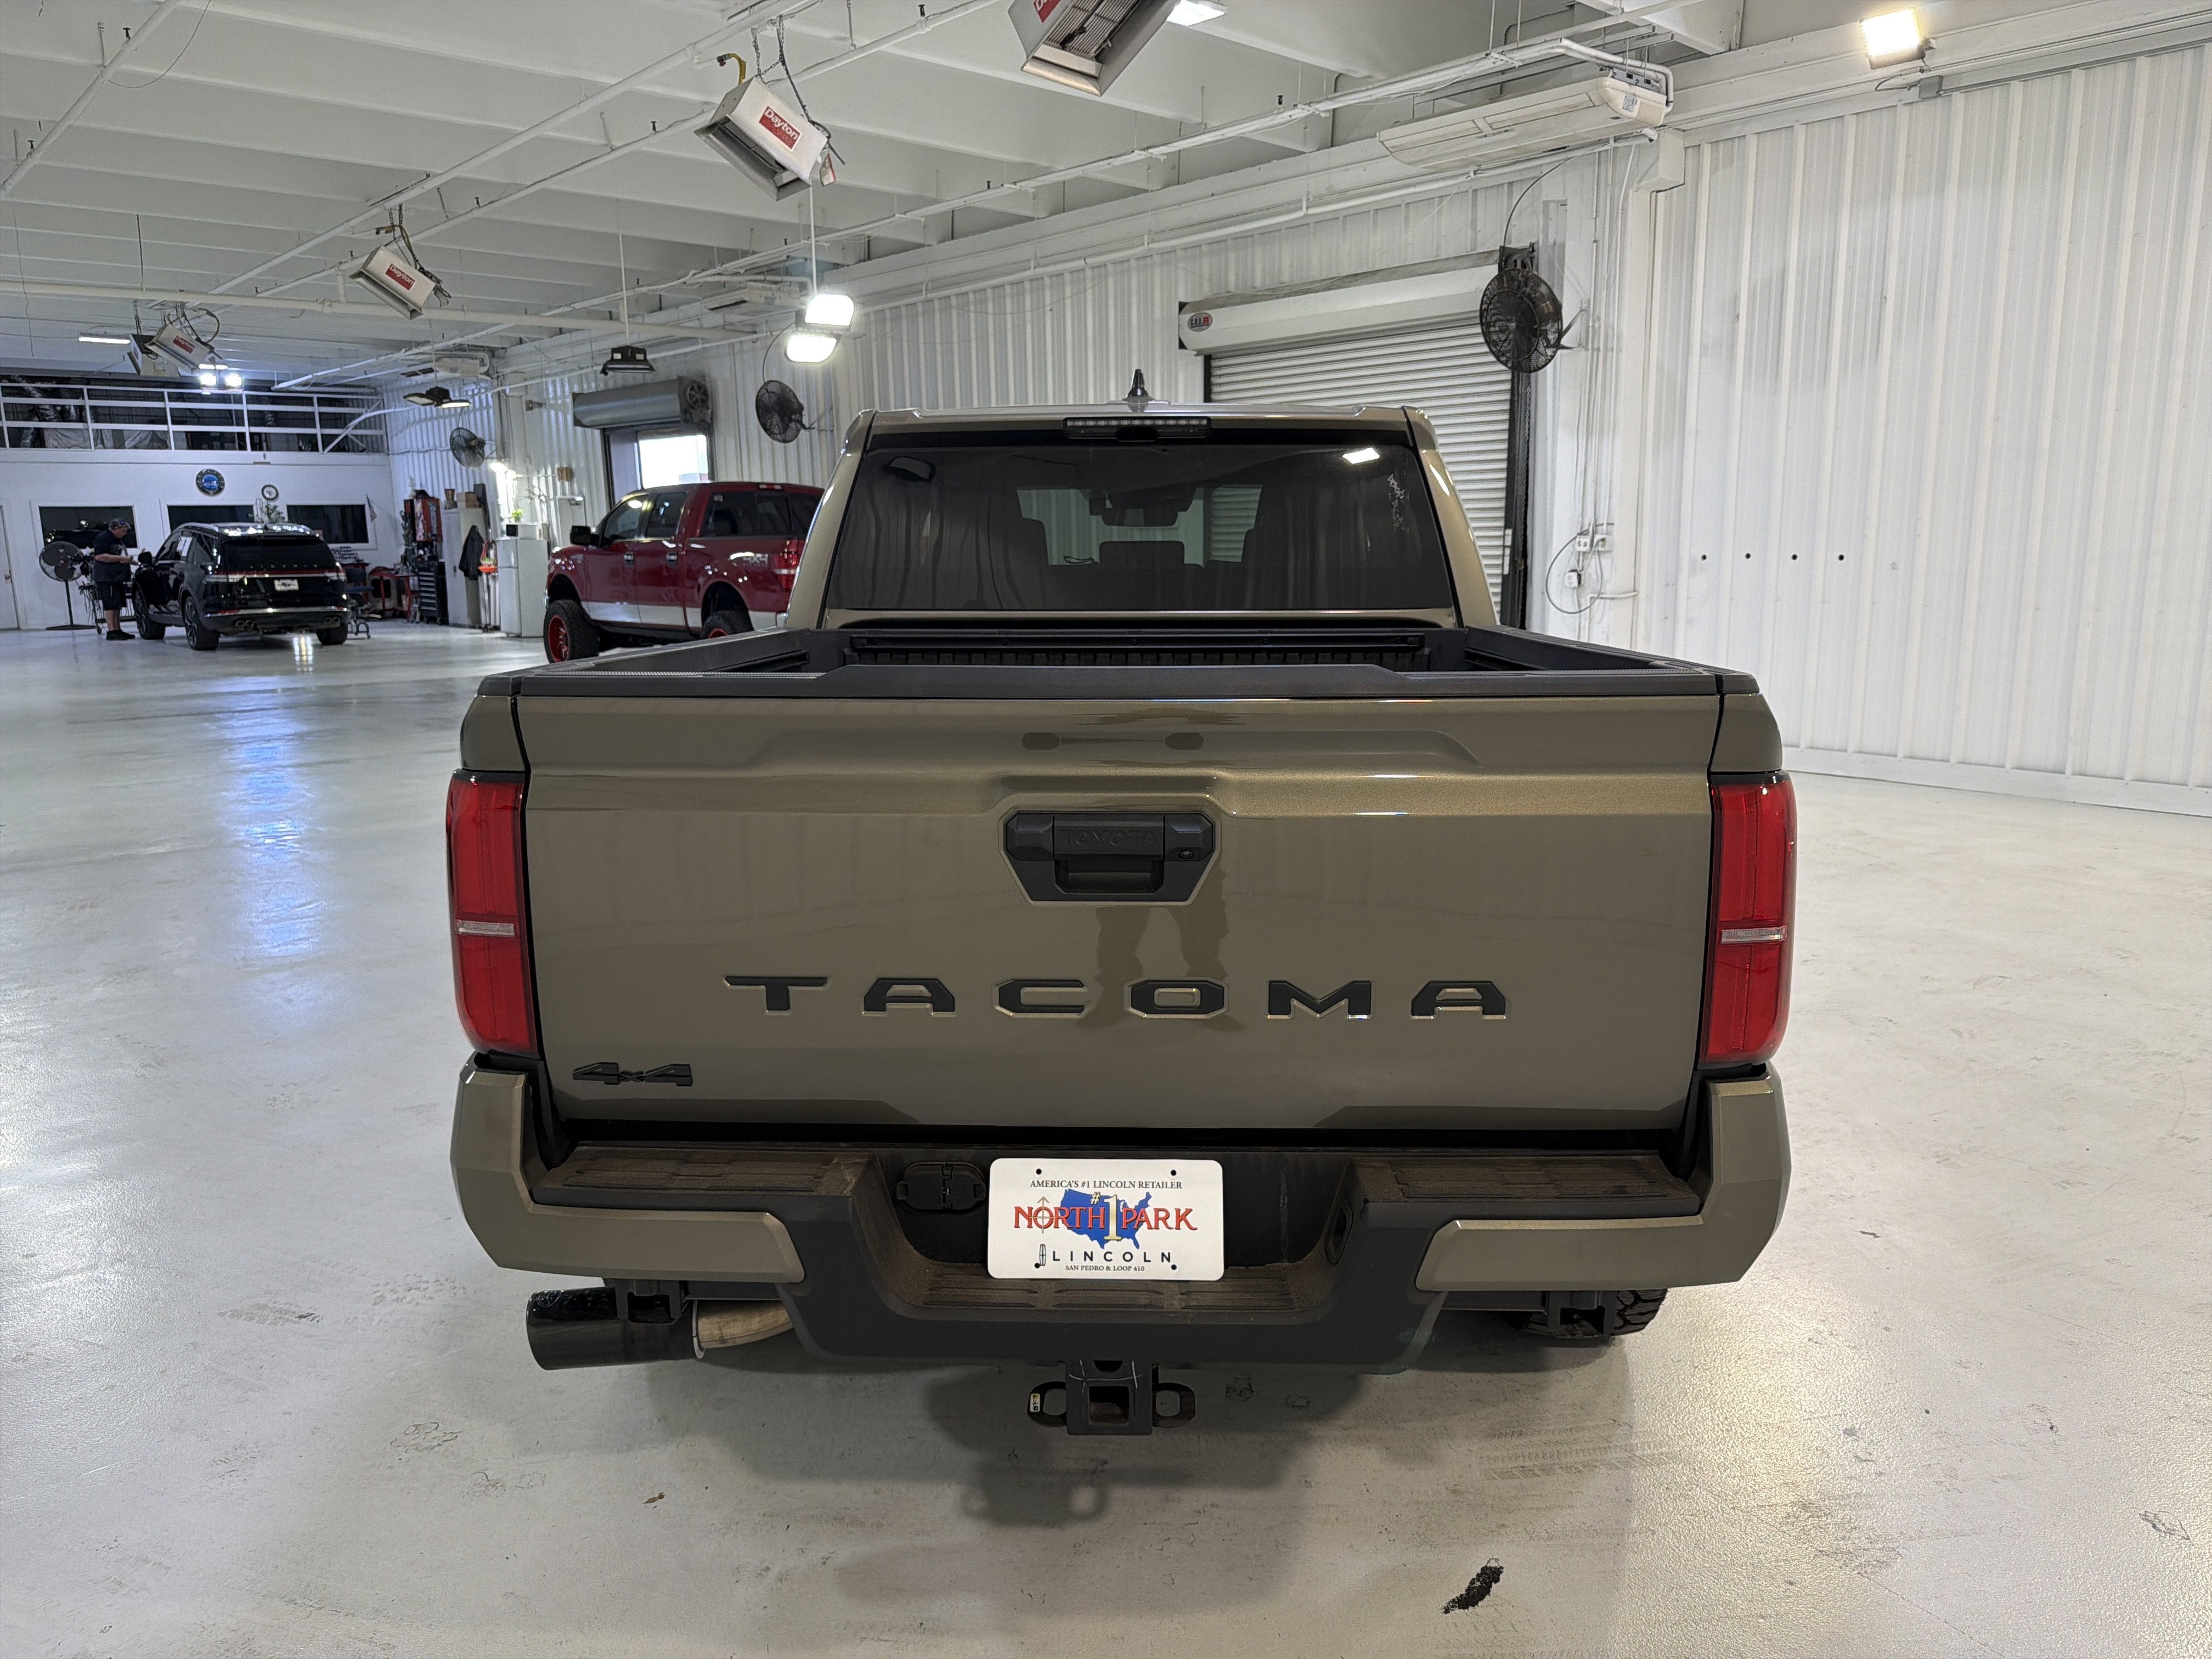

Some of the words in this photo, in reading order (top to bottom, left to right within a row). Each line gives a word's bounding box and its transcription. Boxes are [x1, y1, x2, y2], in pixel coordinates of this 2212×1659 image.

[764, 108, 798, 140] Dayton
[389, 265, 414, 285] Dayton
[1060, 829, 1159, 847] TOYOTA
[724, 975, 1508, 1020] TACOMA
[1029, 1180, 1079, 1188] AMERICA'S
[1081, 1180, 1091, 1189] #1
[1092, 1180, 1136, 1189] LINCOLN
[1137, 1181, 1182, 1189] RETAILER
[1013, 1206, 1105, 1229] NORTH
[1122, 1207, 1198, 1231] PARK
[1052, 1250, 1171, 1263] LINCOLN
